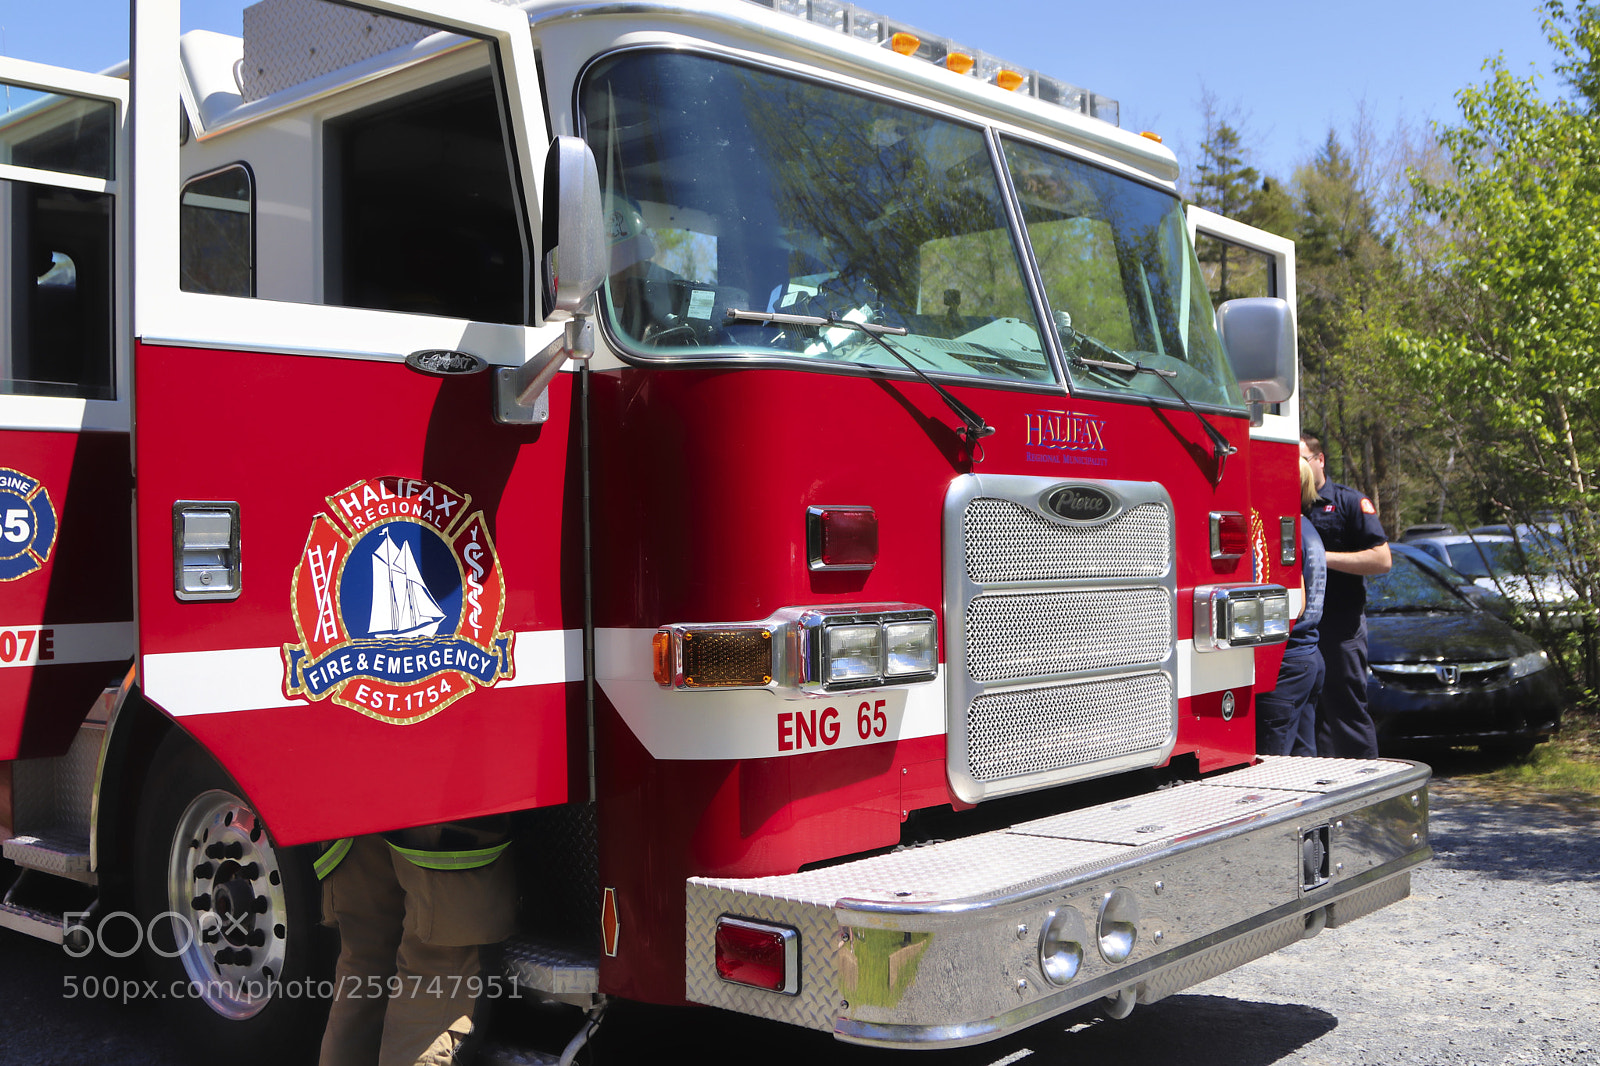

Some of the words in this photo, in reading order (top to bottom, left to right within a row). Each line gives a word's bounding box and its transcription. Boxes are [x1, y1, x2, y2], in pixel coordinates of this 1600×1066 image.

[1024, 410, 1107, 452] HALIFAX
[339, 478, 458, 518] HALIFAX
[352, 501, 442, 529] REGIONAL
[1055, 490, 1105, 513] Pierce
[0, 508, 30, 543] 5
[0, 629, 55, 664] 07E
[308, 654, 353, 690] FIRE
[356, 652, 369, 671] &
[373, 648, 491, 675] EMERGENCY
[777, 706, 841, 752] ENG
[857, 699, 888, 740] 65
